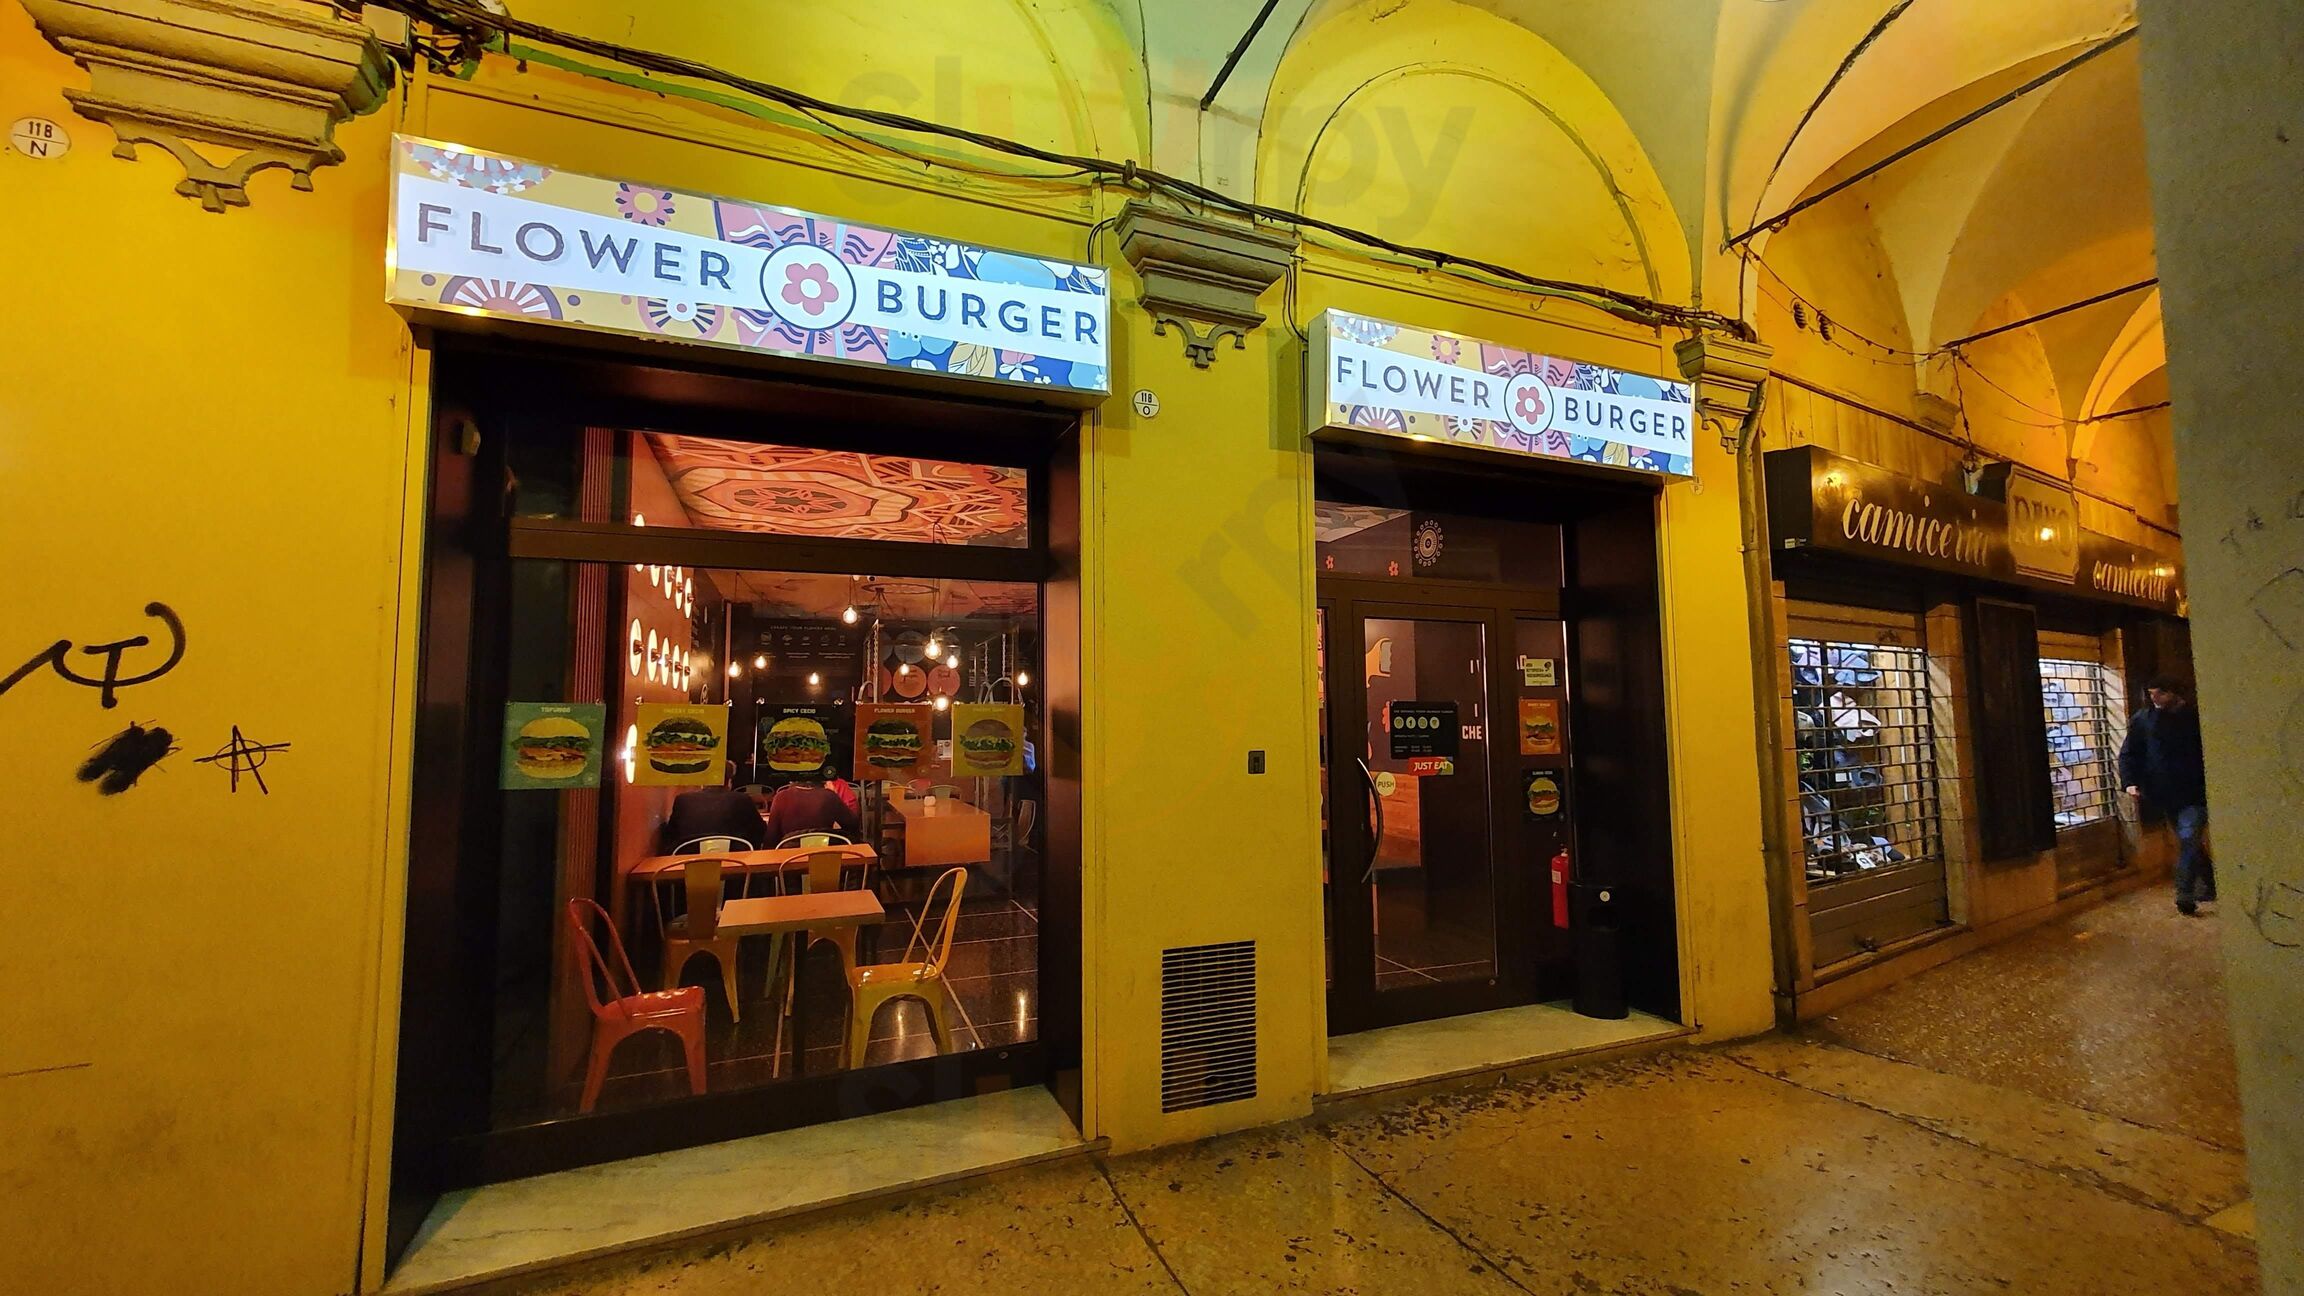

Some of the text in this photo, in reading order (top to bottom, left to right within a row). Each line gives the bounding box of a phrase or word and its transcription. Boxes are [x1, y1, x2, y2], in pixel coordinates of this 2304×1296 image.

[28, 121, 53, 138] 118
[30, 140, 47, 156] N
[417, 202, 1100, 346] FLOWER BURGER
[1141, 392, 1153, 403] 118
[1336, 356, 1688, 441] FLOWER BURGER
[1413, 761, 1449, 772] JUST EAT
